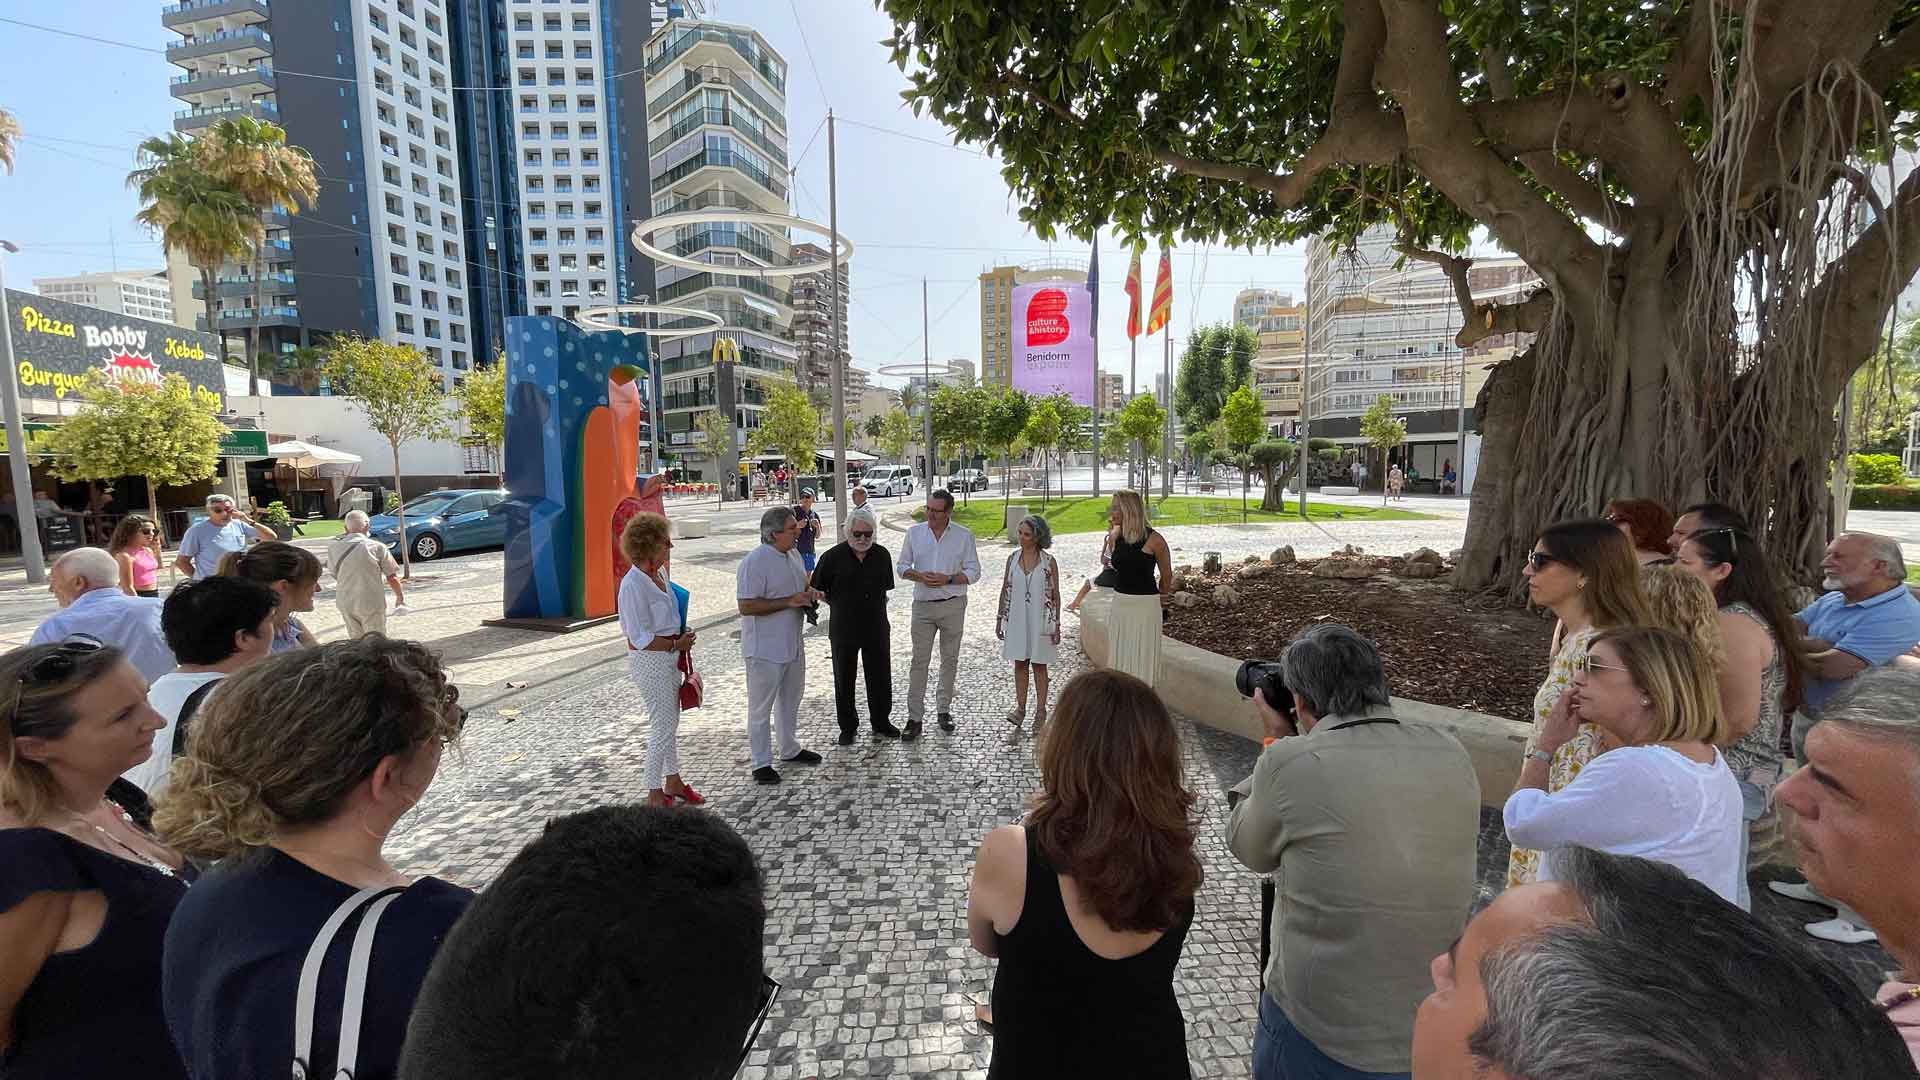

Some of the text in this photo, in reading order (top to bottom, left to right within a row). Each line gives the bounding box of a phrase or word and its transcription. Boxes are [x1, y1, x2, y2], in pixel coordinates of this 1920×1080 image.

[22, 306, 76, 338] Pizza
[1028, 319, 1058, 328] culture
[83, 325, 147, 350] Bobby
[165, 338, 205, 360] Kebab
[1026, 352, 1070, 362] Benidorm
[197, 385, 223, 412] Dog
